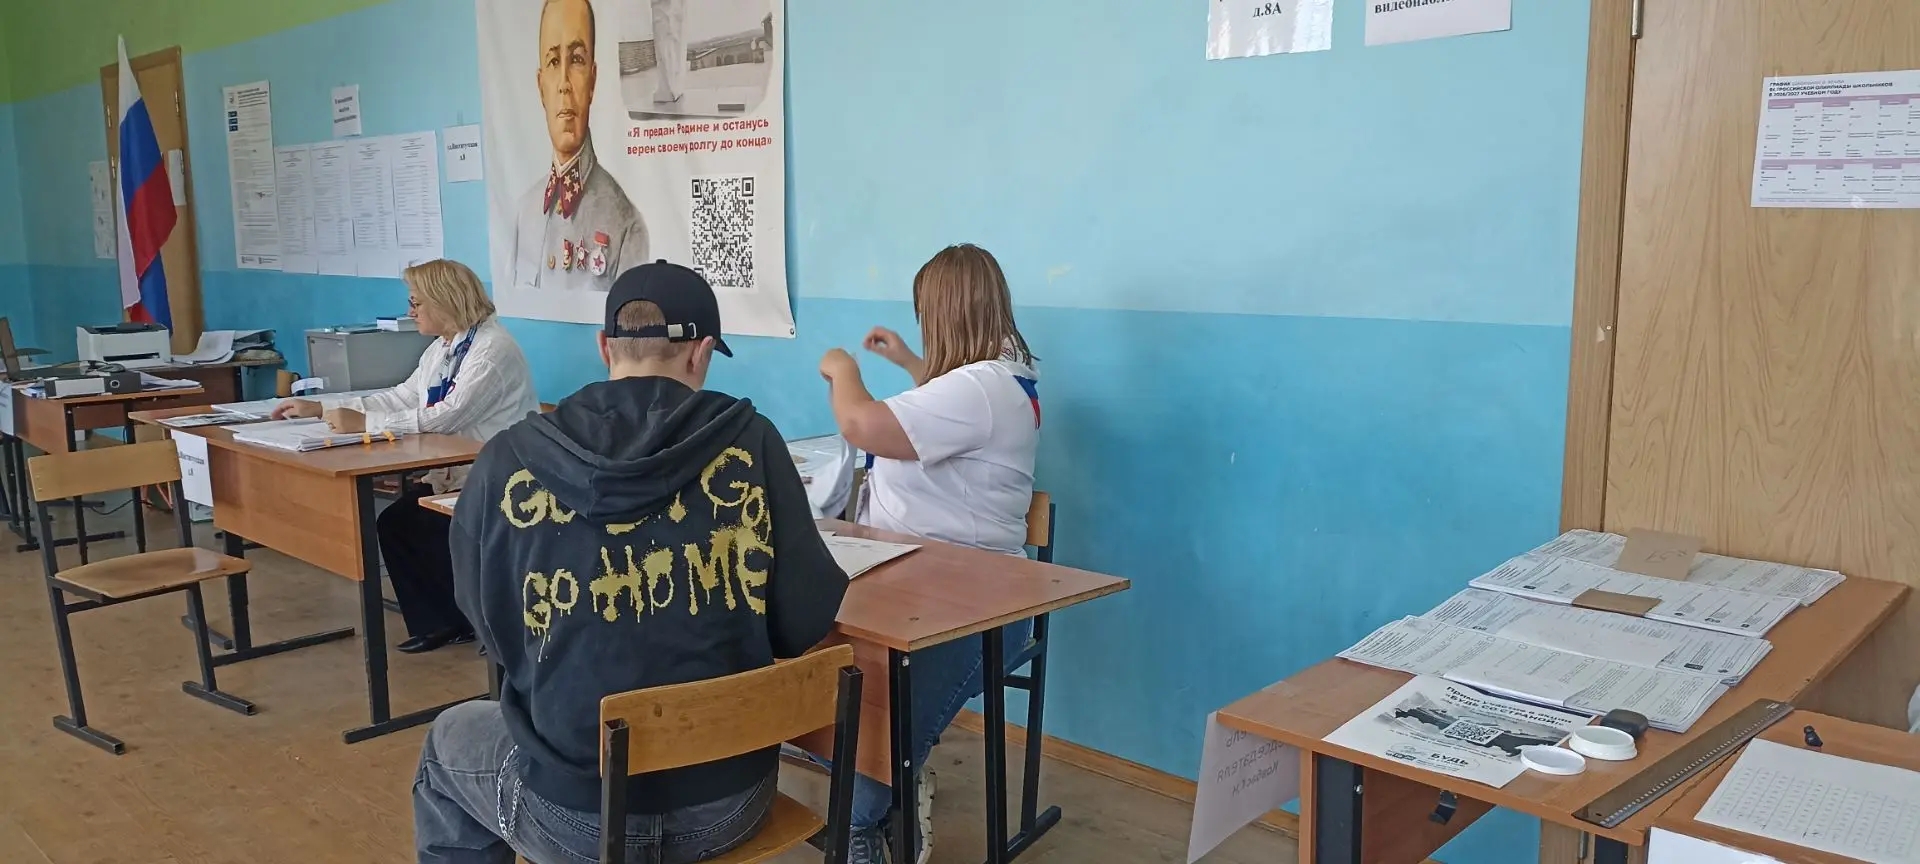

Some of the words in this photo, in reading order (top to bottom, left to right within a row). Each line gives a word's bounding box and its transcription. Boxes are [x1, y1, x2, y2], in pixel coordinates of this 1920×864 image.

[1252, 2, 1282, 18] д.8А
[627, 127, 640, 138] «Я
[643, 125, 675, 139] предан
[676, 122, 710, 135] Родине
[713, 122, 720, 132] и
[722, 117, 769, 132] останусь
[627, 143, 656, 157] верен
[657, 141, 689, 155] своему
[689, 139, 718, 152] долгу
[720, 138, 733, 150] до
[735, 135, 772, 149] конца»
[1445, 693, 1479, 707] «БУДЬ
[1481, 704, 1498, 712] СО
[1446, 686, 1480, 703] Прими
[1482, 699, 1527, 713] участие
[1537, 713, 1572, 724] акции
[1430, 752, 1469, 766] БУДЬ
